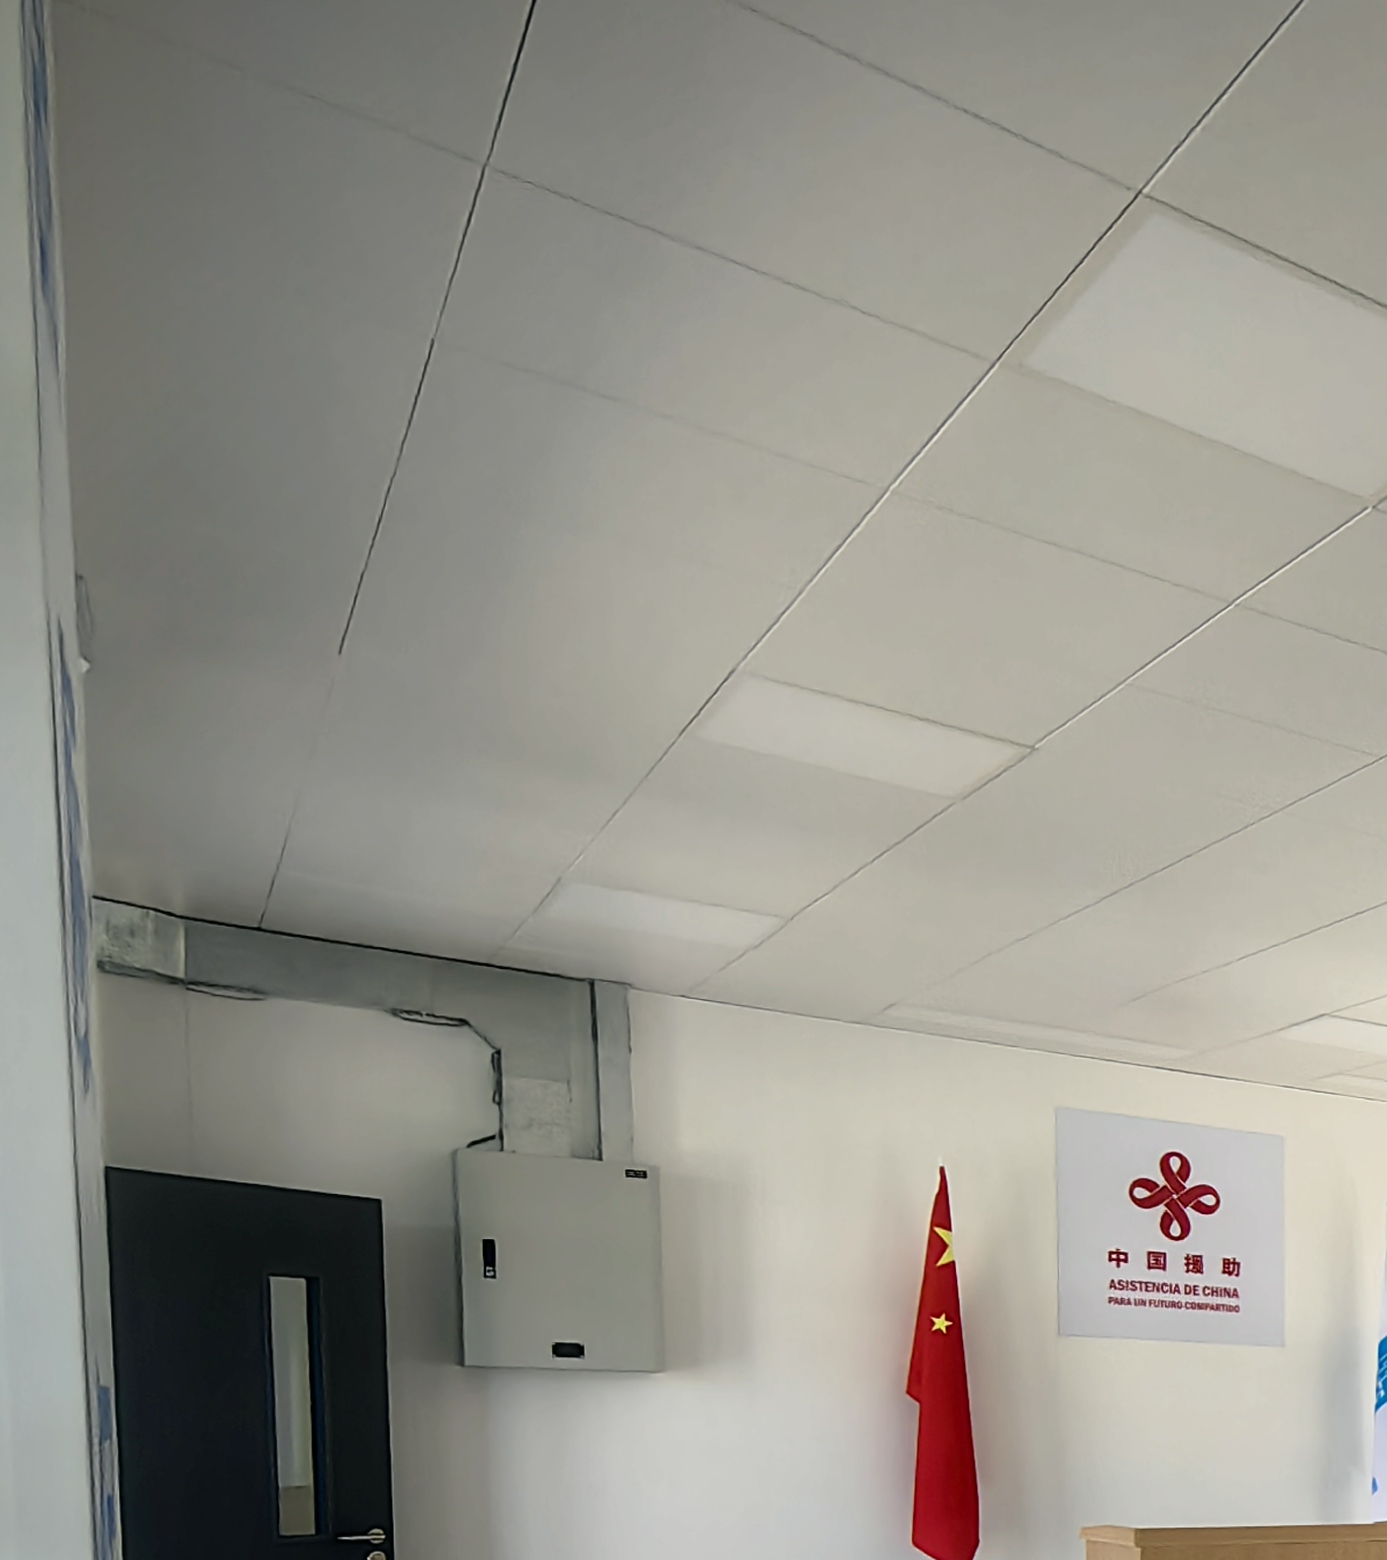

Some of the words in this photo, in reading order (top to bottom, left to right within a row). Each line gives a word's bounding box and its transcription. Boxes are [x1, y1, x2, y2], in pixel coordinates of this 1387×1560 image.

[1108, 1249, 1241, 1277] 中国援助
[1109, 1279, 1181, 1295] ASISTENCIA
[1184, 1284, 1200, 1296] DE
[1202, 1286, 1240, 1299] CHINA
[1108, 1296, 1133, 1306] PARA
[1134, 1298, 1147, 1307] UN
[1149, 1299, 1183, 1310] FUTURO
[1185, 1302, 1241, 1313] COMPARTIDO
